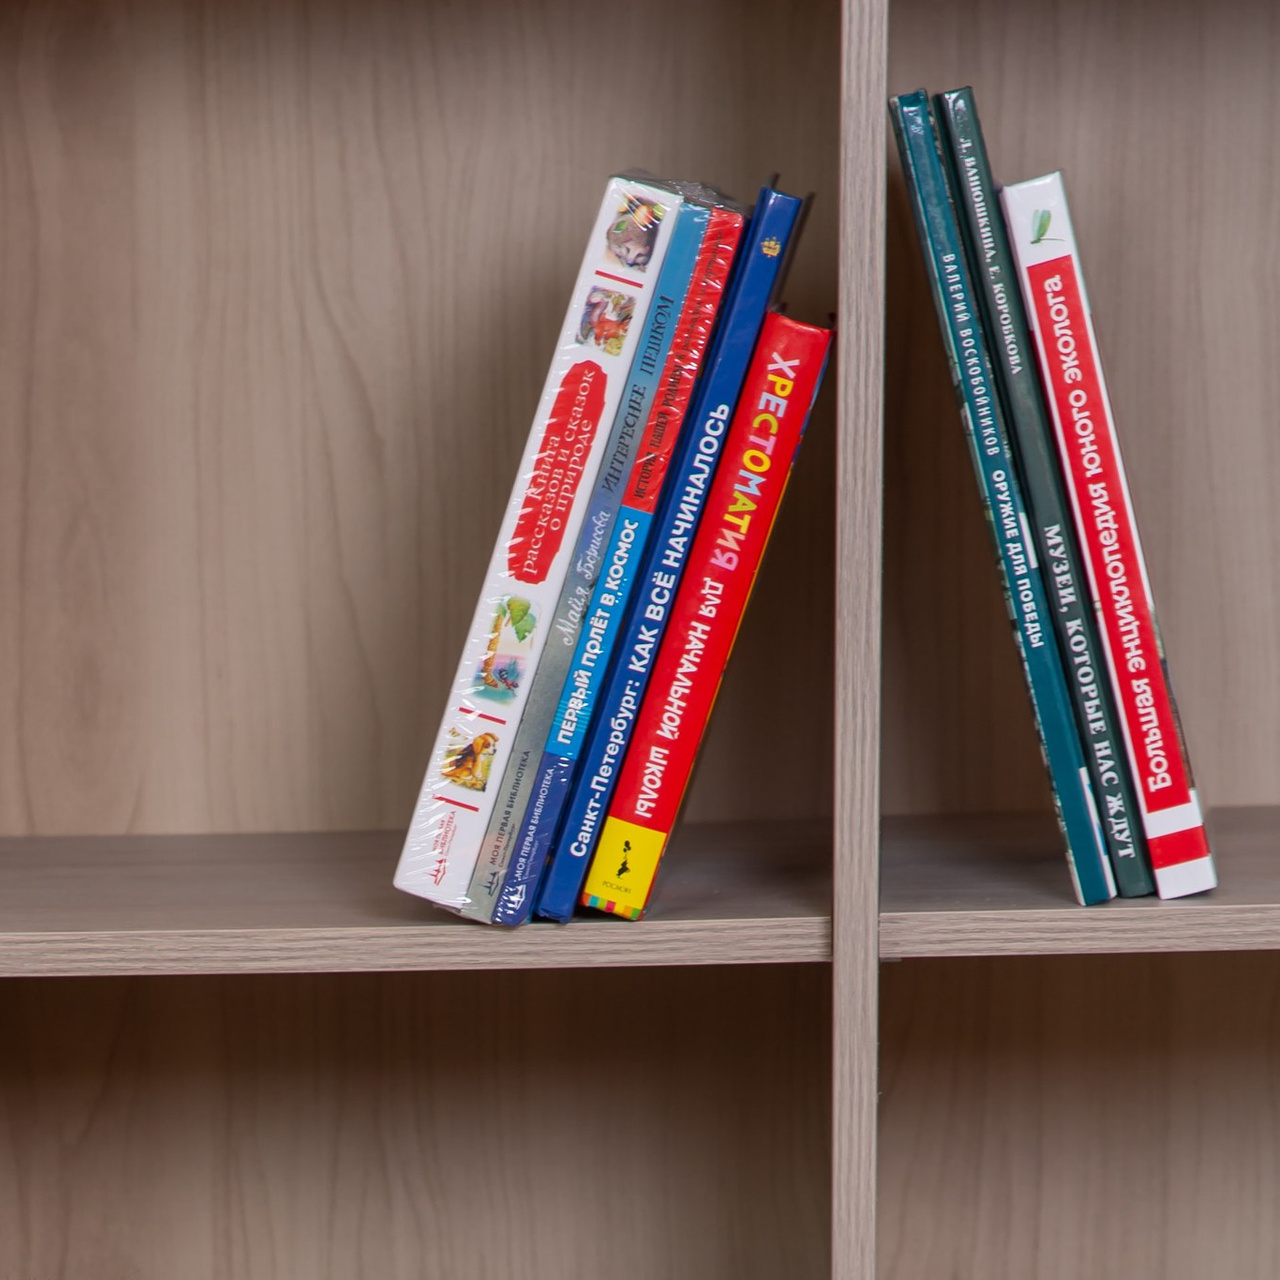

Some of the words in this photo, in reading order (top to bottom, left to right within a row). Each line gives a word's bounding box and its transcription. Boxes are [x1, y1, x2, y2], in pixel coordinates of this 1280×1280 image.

[942, 254, 971, 323] ВАЛЕРИЙ
[960, 328, 1000, 456] ВОСКОБОЙНИКОВ
[993, 283, 1023, 375] КОРОБКОВА
[1044, 274, 1083, 384] эколога
[557, 449, 570, 462] и
[565, 369, 596, 442] сказок
[602, 384, 647, 494] ИНТЕРЕСНЕЕ
[641, 295, 675, 376] ПЕШКОМ
[1069, 389, 1104, 478] юного
[550, 518, 561, 531] о
[556, 418, 593, 512] природе
[634, 451, 657, 499] ИСТОРИЯ
[648, 410, 670, 449] НАШЕЙ
[710, 351, 800, 572] ХРЕСТОМАТИЯ
[992, 469, 1019, 538] ОРУЖИЕ
[577, 510, 611, 580] Борисова
[1005, 542, 1028, 576] ДЛЯ
[1044, 524, 1077, 613] МУЗЕИ,
[1088, 481, 1147, 674] энциклопедия
[557, 670, 592, 744] ПЕРВЫЙ
[581, 607, 611, 667] ПОЛЁТ
[600, 593, 616, 607] В
[611, 519, 639, 592] КОСМОС
[570, 679, 640, 857] Санкт-Петербург:
[628, 624, 659, 673] КАК
[645, 572, 676, 621] ВСЁ
[662, 403, 730, 568] НАЧИНАЛОСЬ
[699, 577, 724, 619] ДЛЯ
[1017, 578, 1045, 649] ПОБЕДЫ
[656, 620, 711, 741] НАЧАЛЬНОЙ
[1065, 618, 1107, 735] КОТОРЫЕ
[635, 746, 669, 819] ШКОЛЫ
[1093, 740, 1120, 787] НАС
[1132, 678, 1173, 792] Большая
[490, 844, 502, 866] МОЯ
[498, 809, 512, 844] ПЕРВАЯ
[508, 750, 531, 807] БИБЛИОТЕКА
[515, 859, 526, 881] МОЯ
[521, 825, 536, 859] ПЕРВАЯ
[533, 768, 554, 825] БИБЛИОТЕКА
[1105, 791, 1136, 859] ЖДУТ
